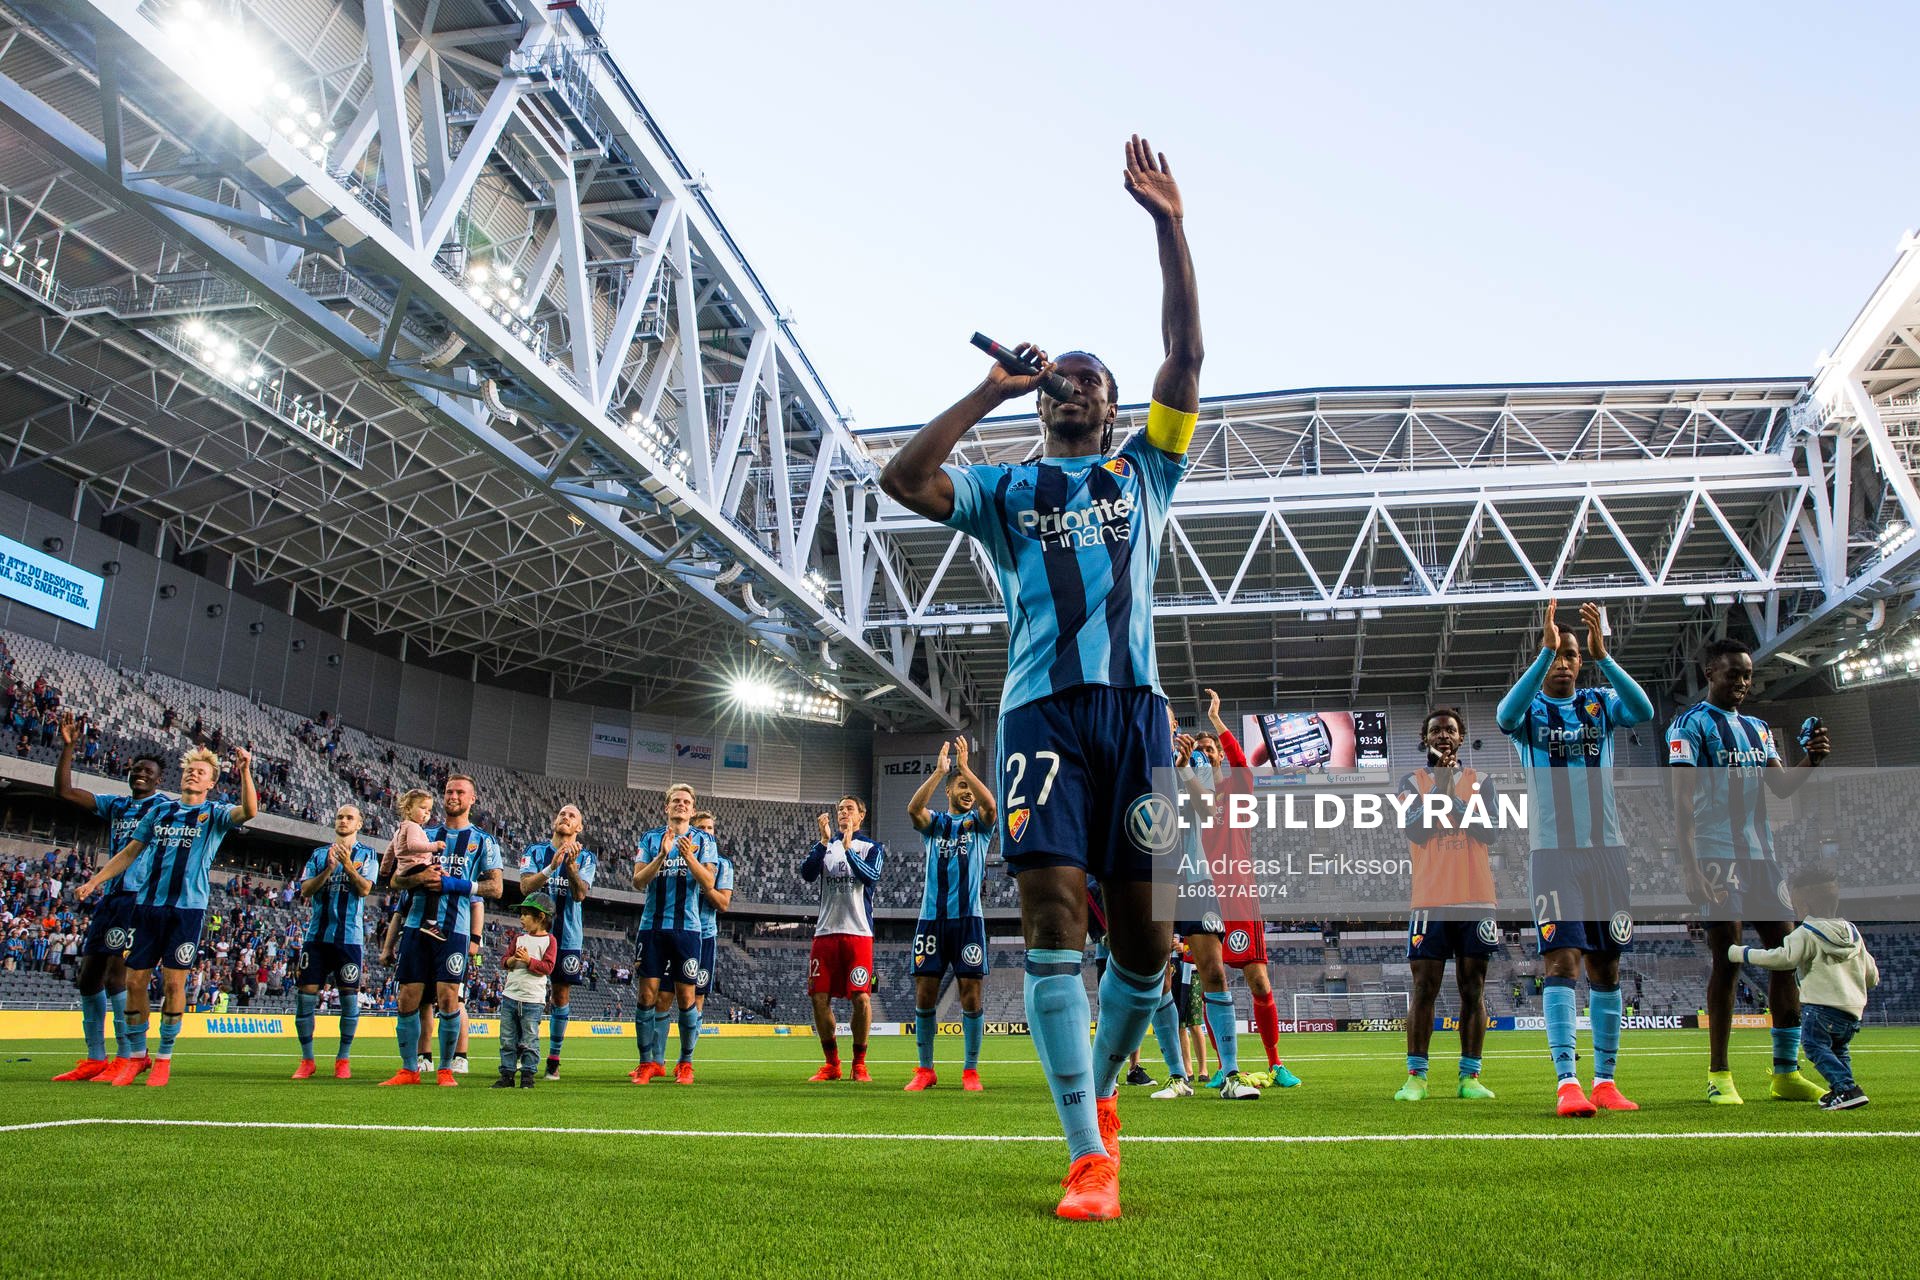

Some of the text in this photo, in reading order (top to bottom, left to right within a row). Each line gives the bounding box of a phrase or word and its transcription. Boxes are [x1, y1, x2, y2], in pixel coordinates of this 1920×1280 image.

[1018, 492, 1137, 537] Prioritet
[1040, 522, 1131, 552] Finans
[7, 556, 27, 572] ATT
[28, 565, 42, 578] DU
[43, 571, 84, 595] BESÖKTE
[15, 571, 33, 587] SES
[34, 580, 66, 599] SNART
[66, 592, 90, 610] IGEN.
[1358, 720, 1365, 730] 2
[1376, 720, 1382, 730] 1
[1360, 736, 1383, 744] 93:36
[690, 744, 712, 753] INTER
[690, 752, 712, 761] SPORT
[1548, 741, 1600, 758] Finans
[1716, 747, 1767, 766] Priorite
[884, 760, 920, 775] TELE2
[1727, 763, 1764, 778] Finan
[1006, 751, 1060, 808] 27
[1336, 774, 1366, 782] Fortum
[154, 824, 202, 838] Prioritet
[157, 837, 193, 848] Finans
[1706, 862, 1740, 890] 24
[1536, 890, 1562, 925] 21
[1412, 910, 1428, 935] 11
[125, 928, 136, 949] 3
[915, 934, 937, 955] 58
[1251, 1020, 1334, 1032] Pitet Finans
[1621, 1015, 1682, 1029] SERNEKE
[1062, 1091, 1086, 1106] DIF
